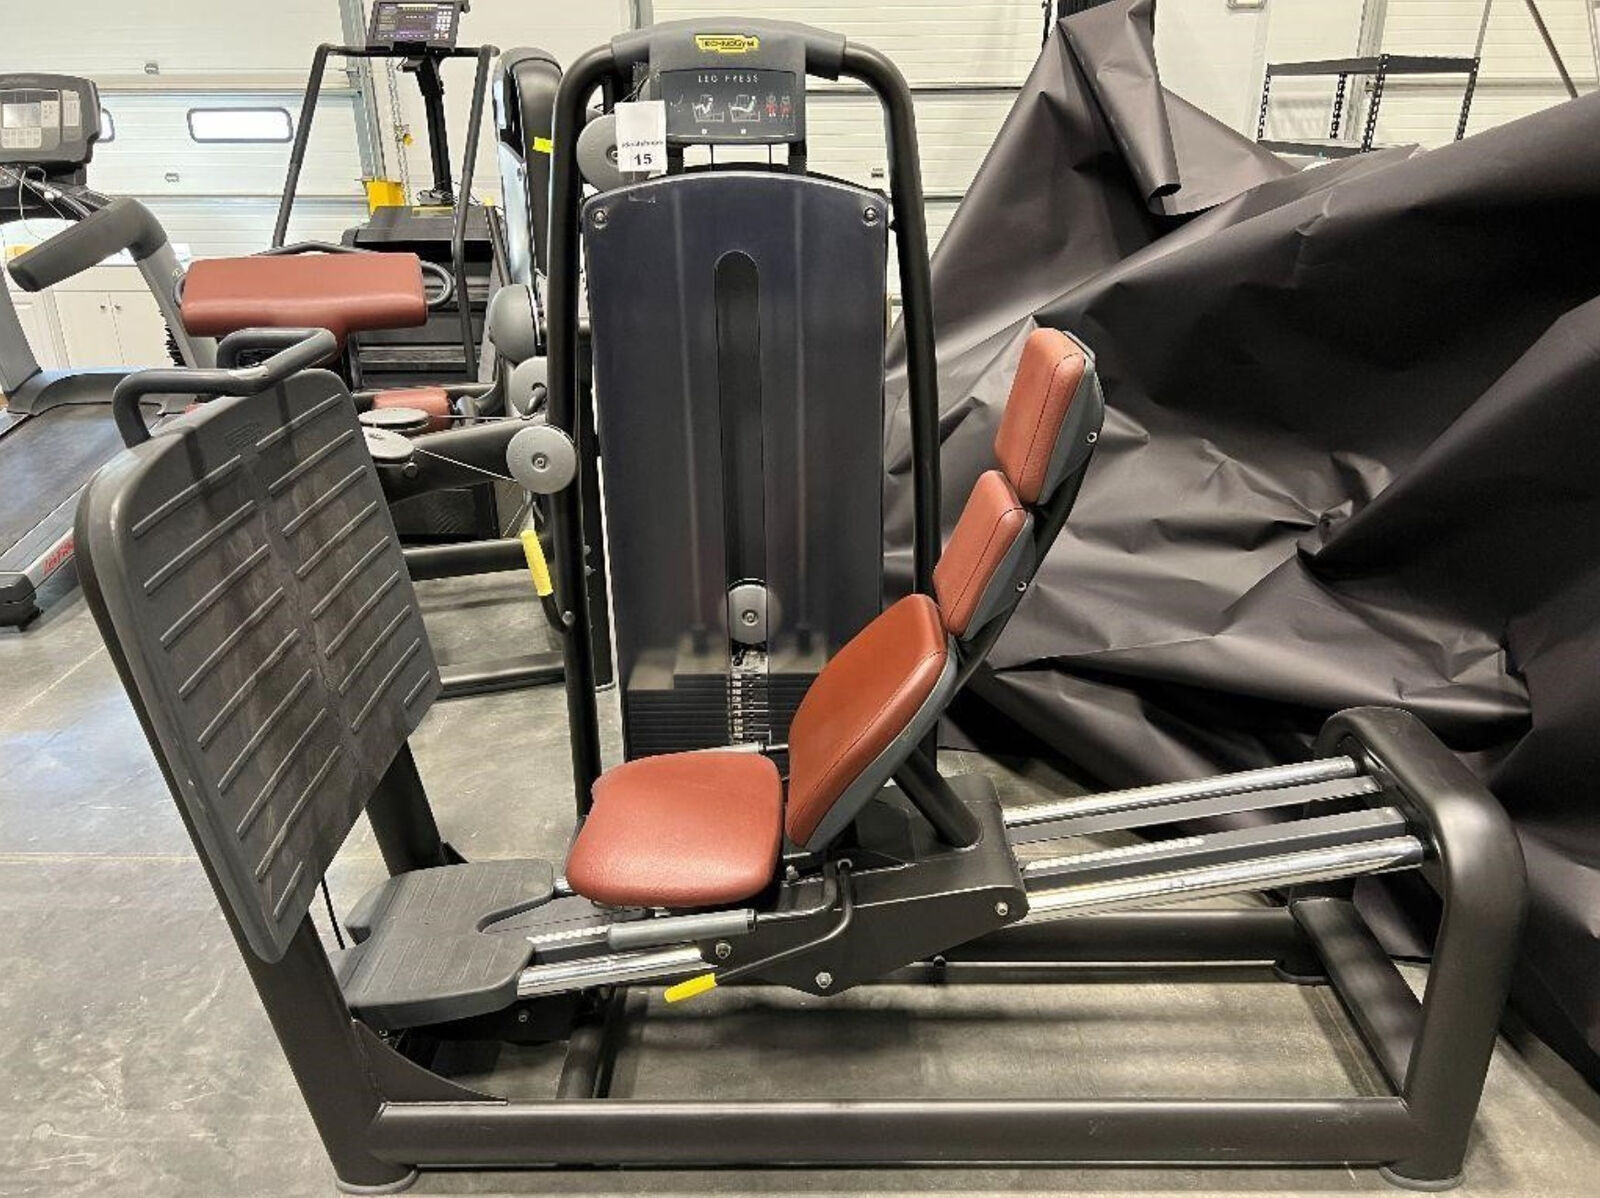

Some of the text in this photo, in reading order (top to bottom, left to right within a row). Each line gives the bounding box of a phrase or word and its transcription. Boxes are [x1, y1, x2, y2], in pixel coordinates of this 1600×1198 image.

[698, 73, 759, 83] LEG PRESS
[634, 153, 653, 166] 15
